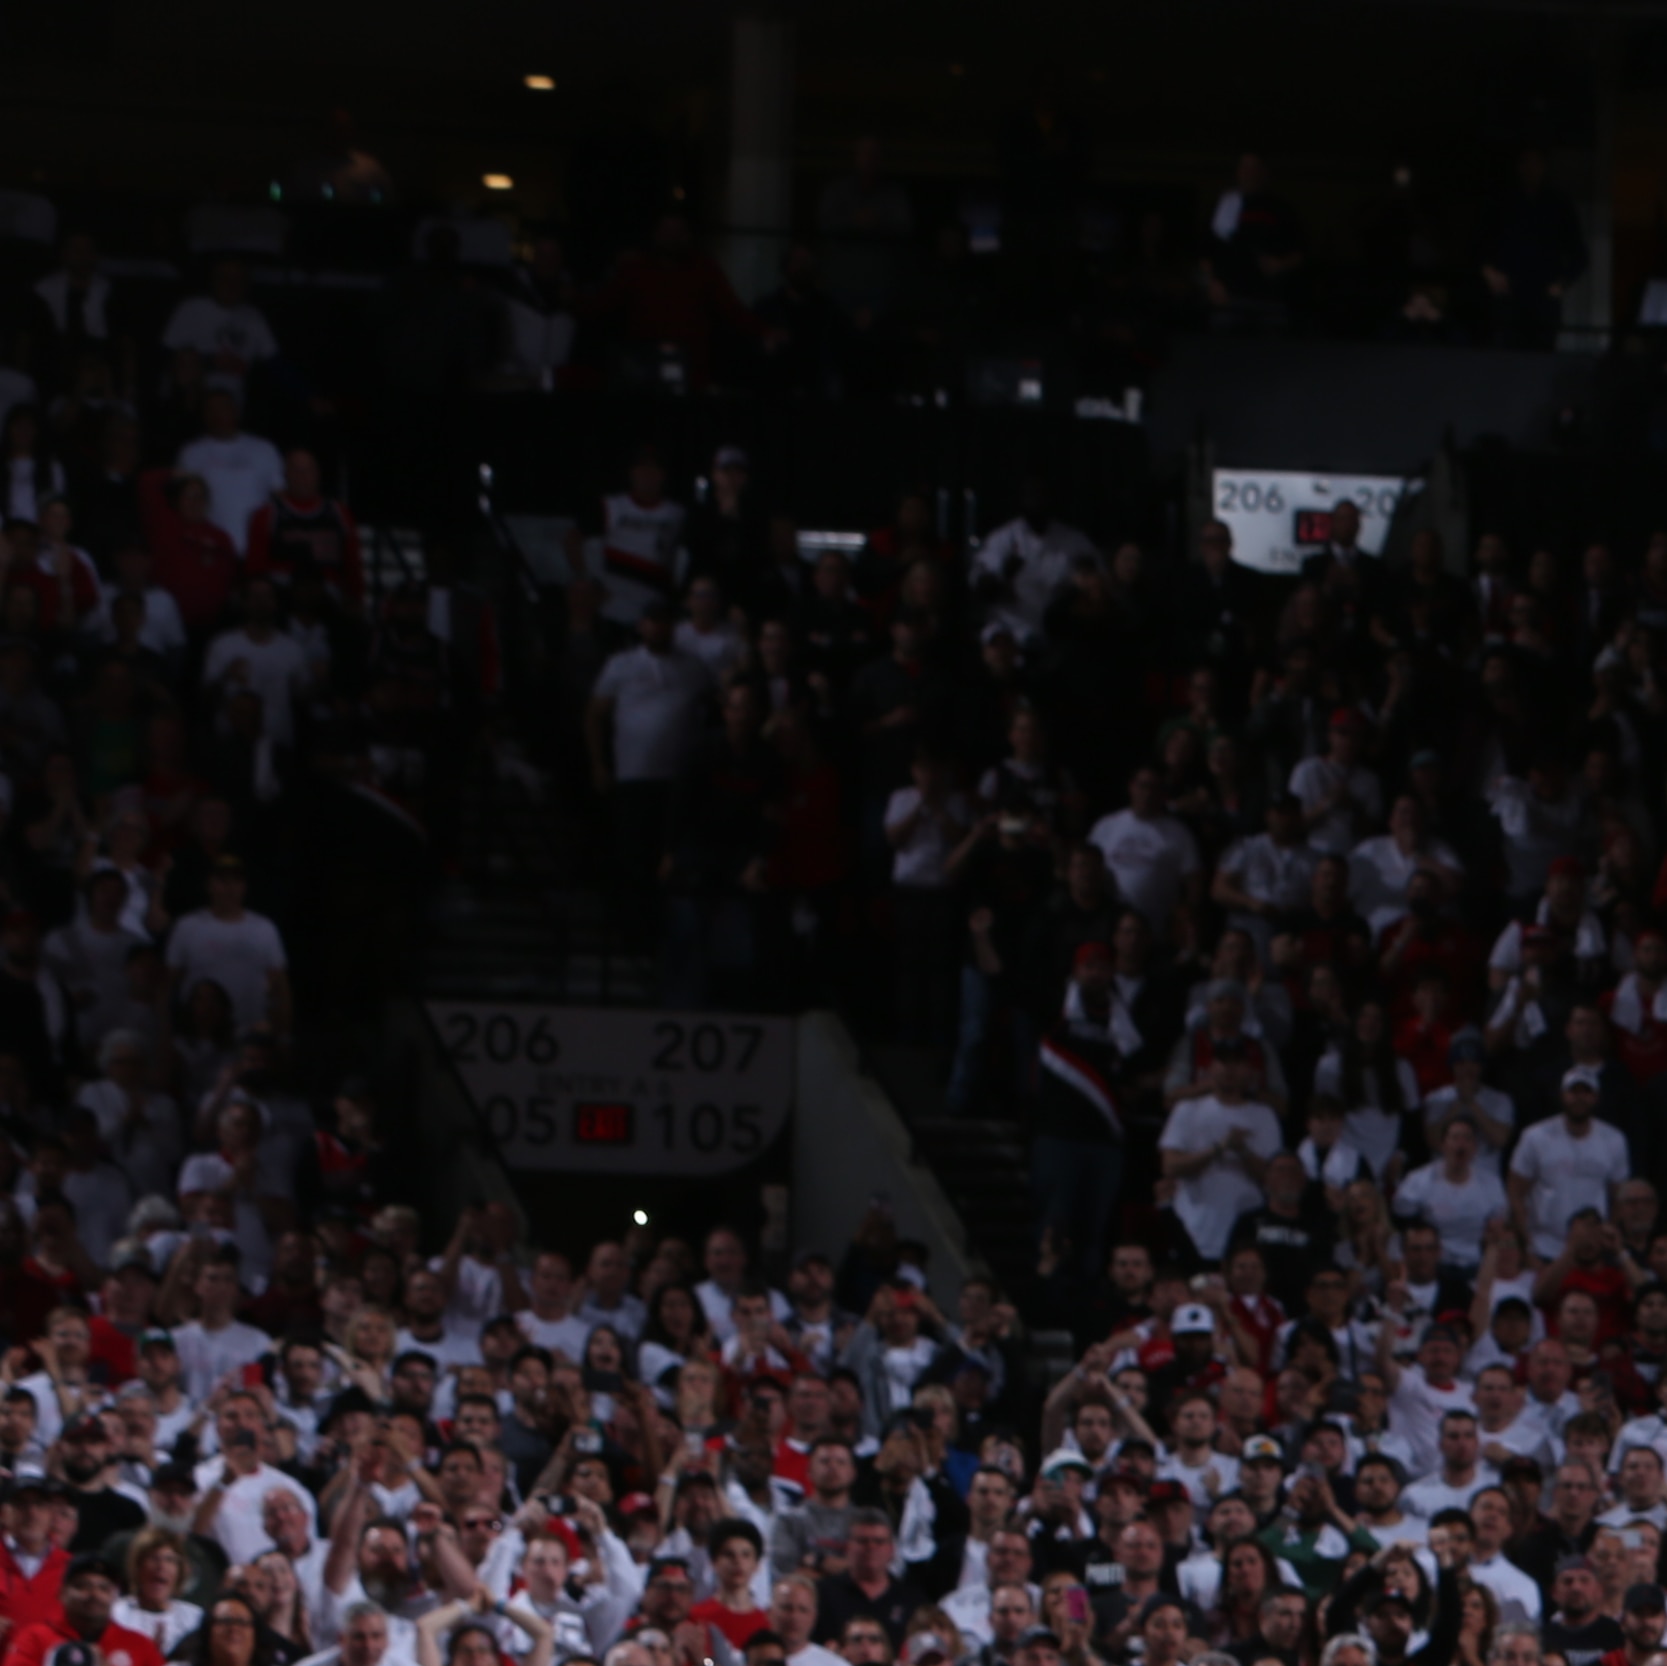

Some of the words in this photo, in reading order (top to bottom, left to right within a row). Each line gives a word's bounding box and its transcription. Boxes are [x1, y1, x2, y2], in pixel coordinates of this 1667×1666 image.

[1218, 481, 1284, 513] 206
[446, 1013, 560, 1066] 206
[651, 1021, 765, 1074] 207
[485, 1095, 556, 1146] 05
[653, 1104, 765, 1152] 105
